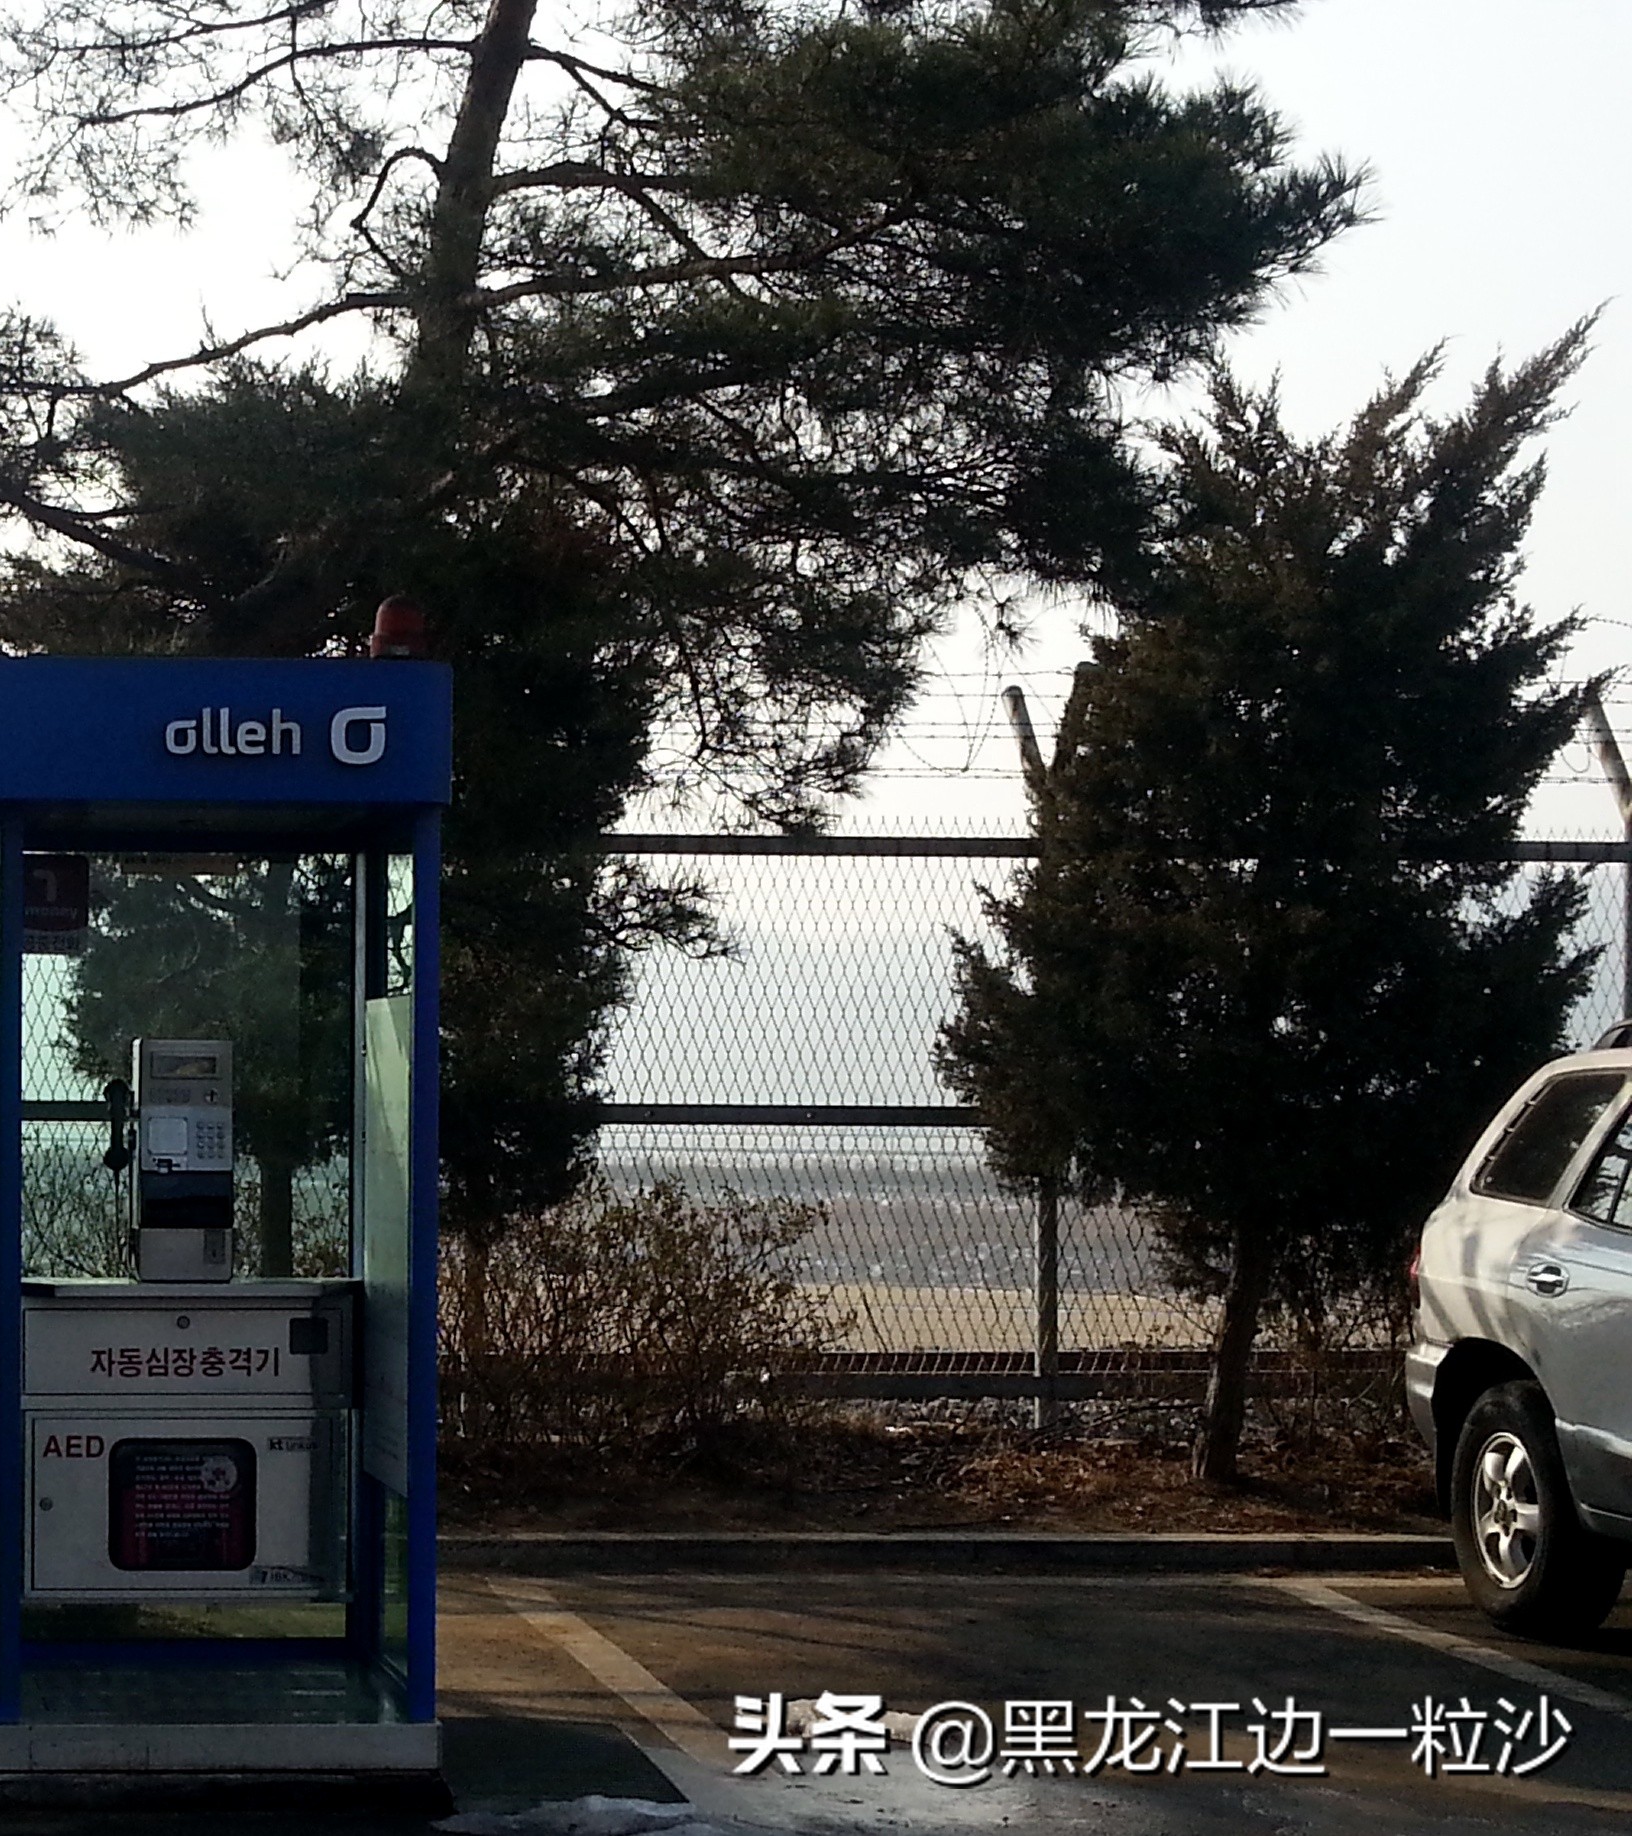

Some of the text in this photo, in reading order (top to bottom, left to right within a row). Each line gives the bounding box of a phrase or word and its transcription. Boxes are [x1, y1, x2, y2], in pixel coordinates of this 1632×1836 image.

[165, 707, 302, 755] olleh
[90, 1346, 280, 1378] 자동심장충격기
[42, 1435, 106, 1459] AED
